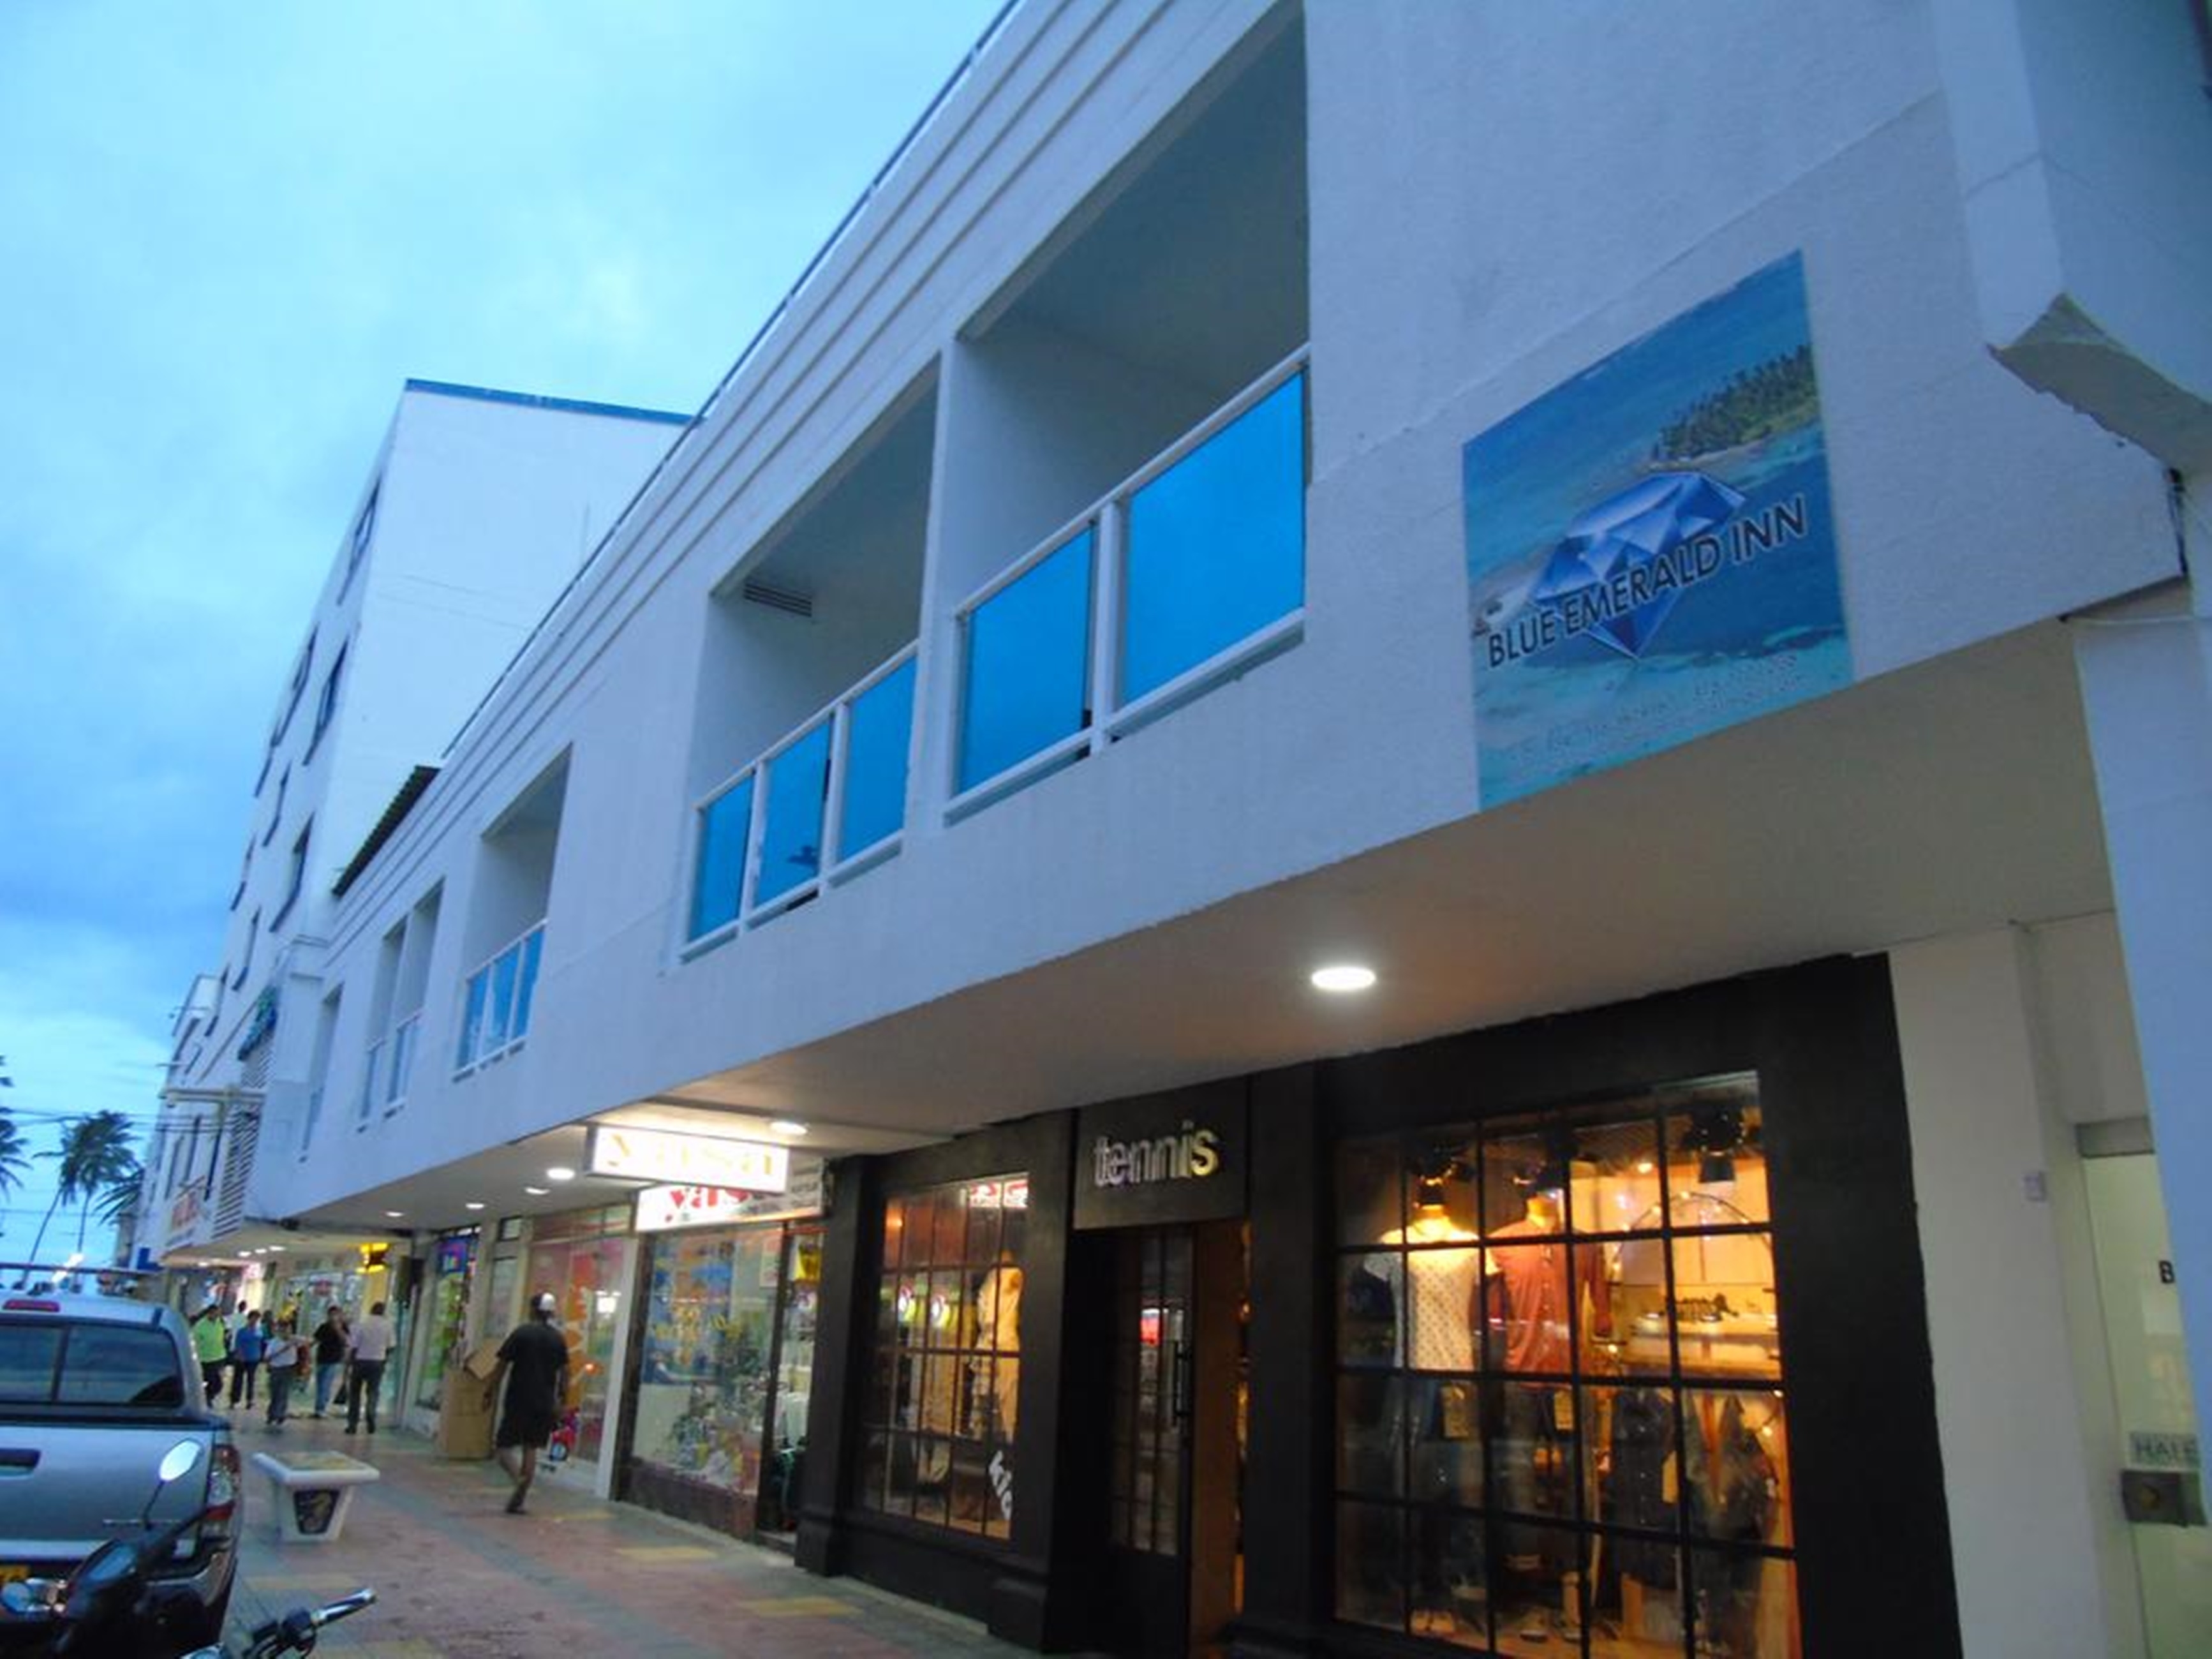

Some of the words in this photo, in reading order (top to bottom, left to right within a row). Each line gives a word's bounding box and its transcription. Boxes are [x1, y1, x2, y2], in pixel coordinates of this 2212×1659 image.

[1488, 609, 1557, 667] BLUE
[1563, 535, 1721, 634] EMERALD
[1732, 496, 1804, 562] INN
[1094, 1119, 1219, 1187] tennis
